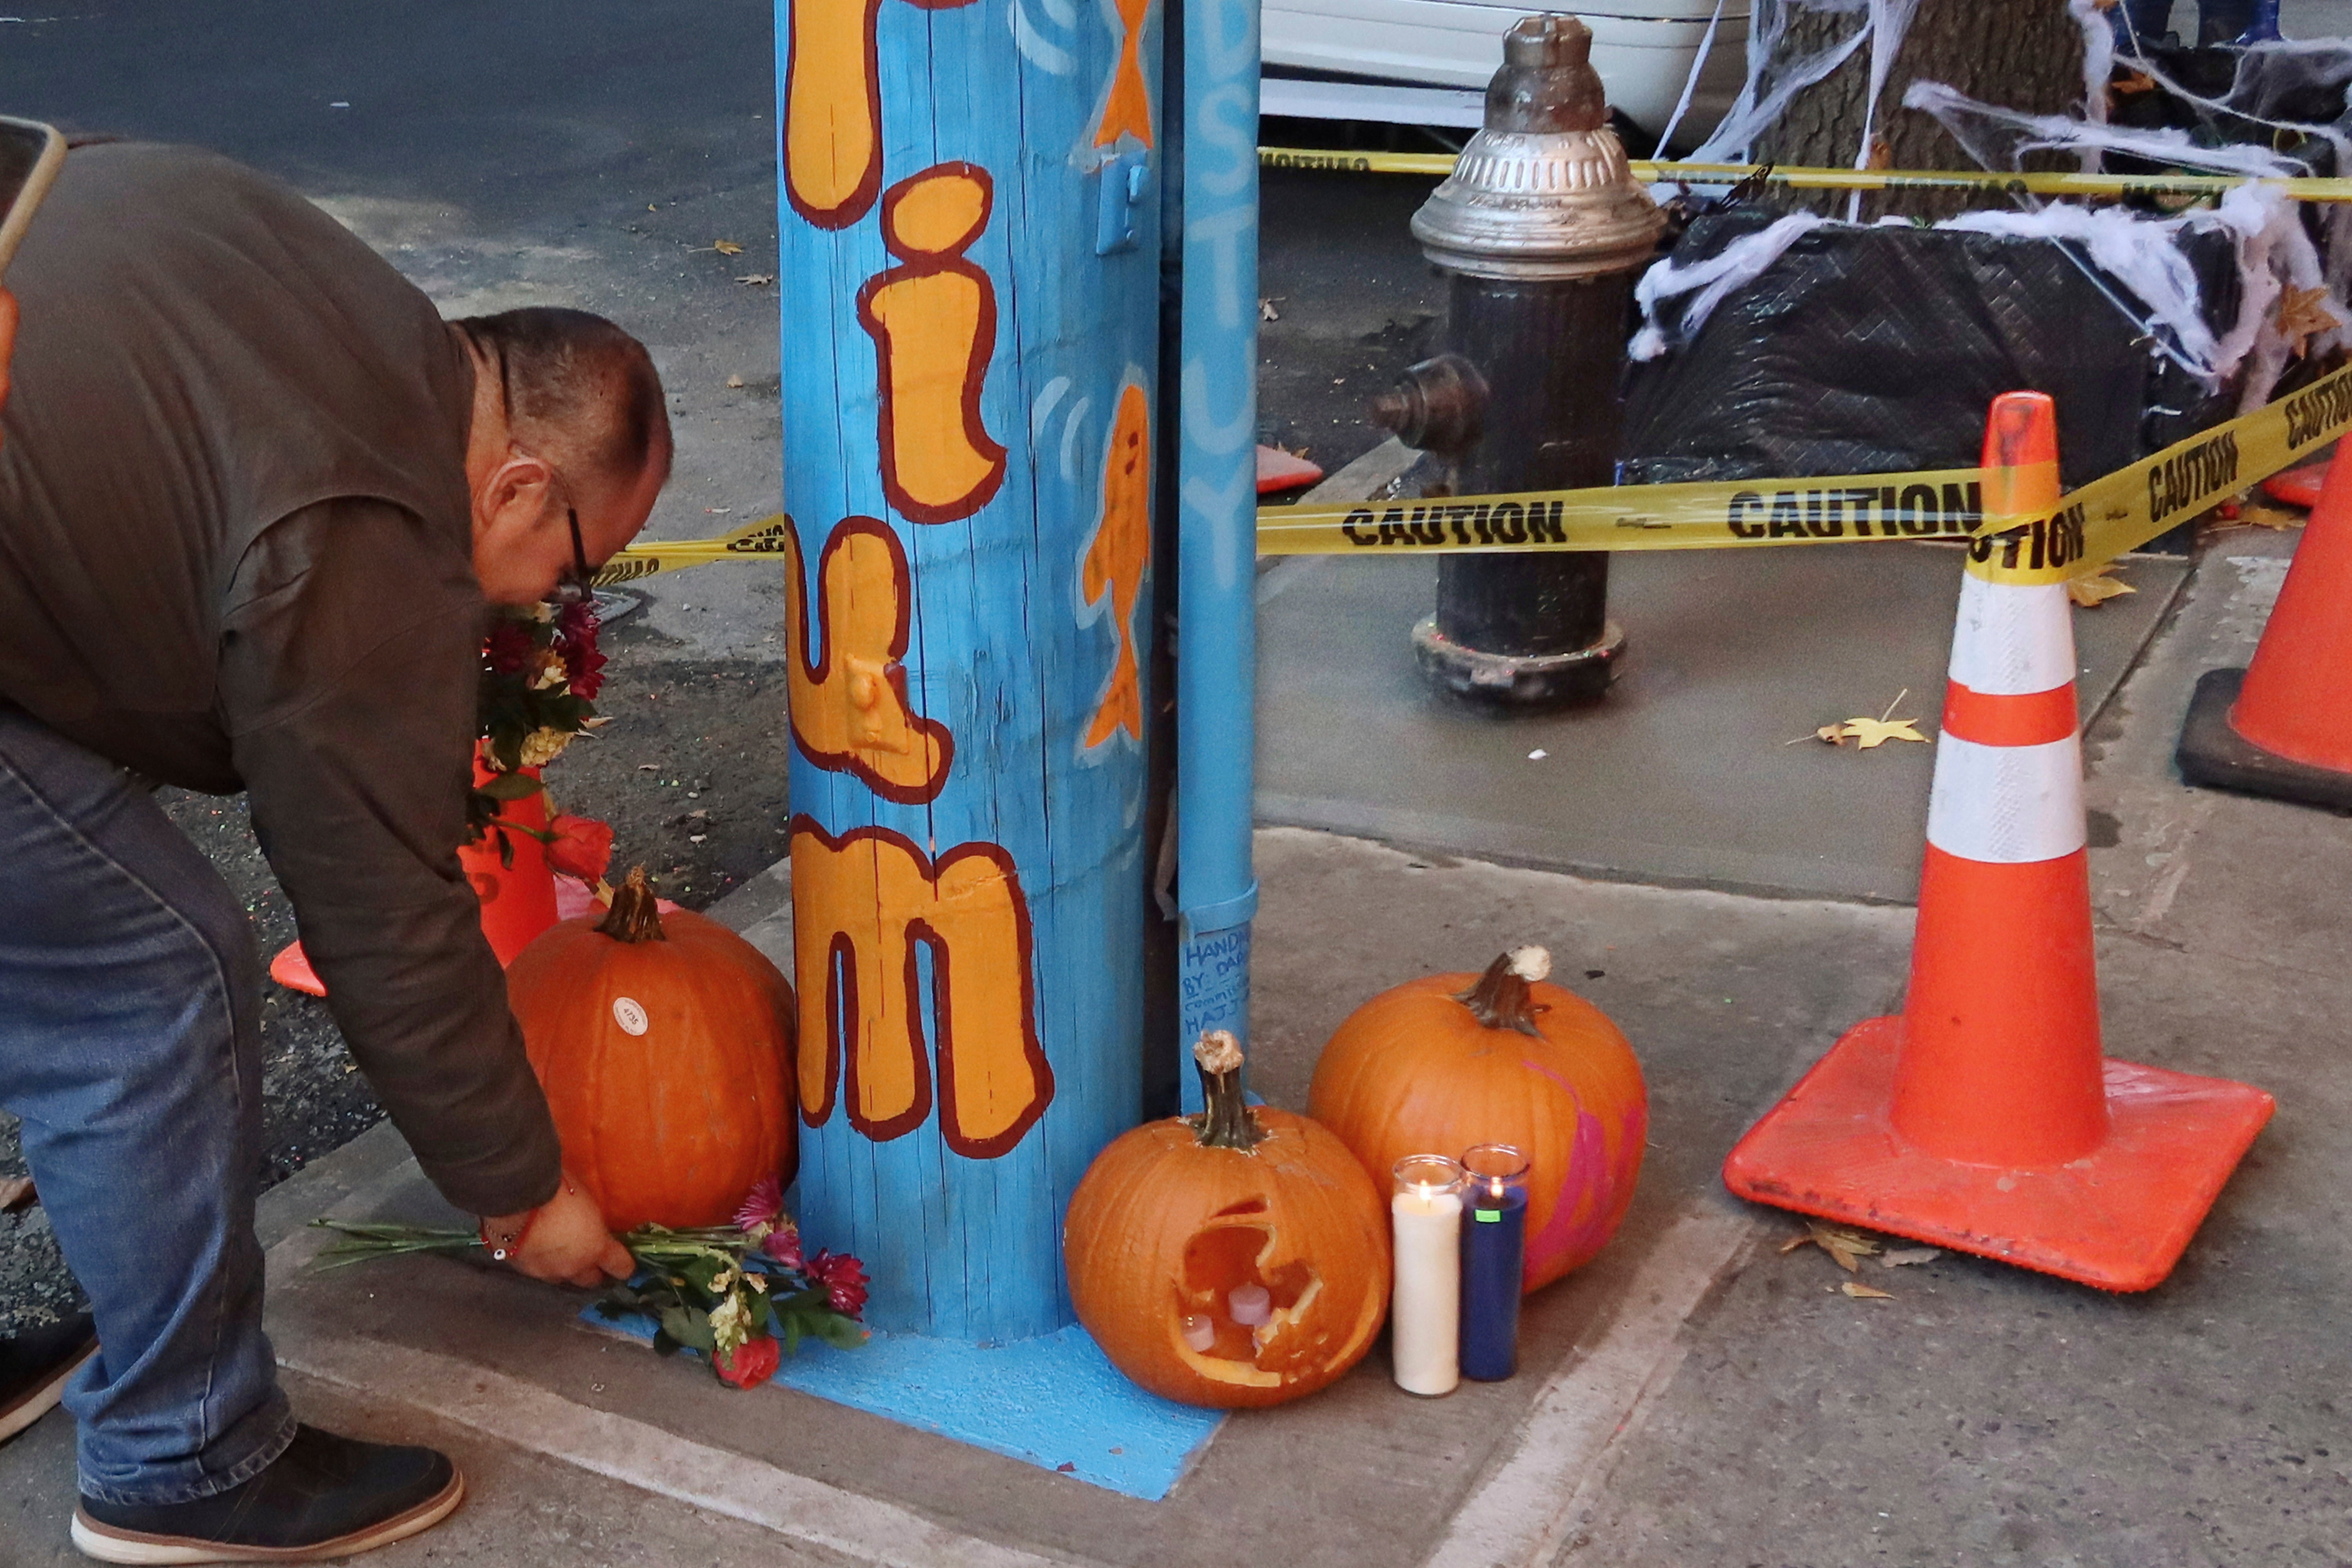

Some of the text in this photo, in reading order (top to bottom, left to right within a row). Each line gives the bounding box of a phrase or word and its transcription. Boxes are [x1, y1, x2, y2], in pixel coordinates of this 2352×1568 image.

[2149, 430, 2238, 523] CAUTION
[1342, 501, 1567, 546] CAUTION
[1728, 481, 1983, 538] CAUTION
